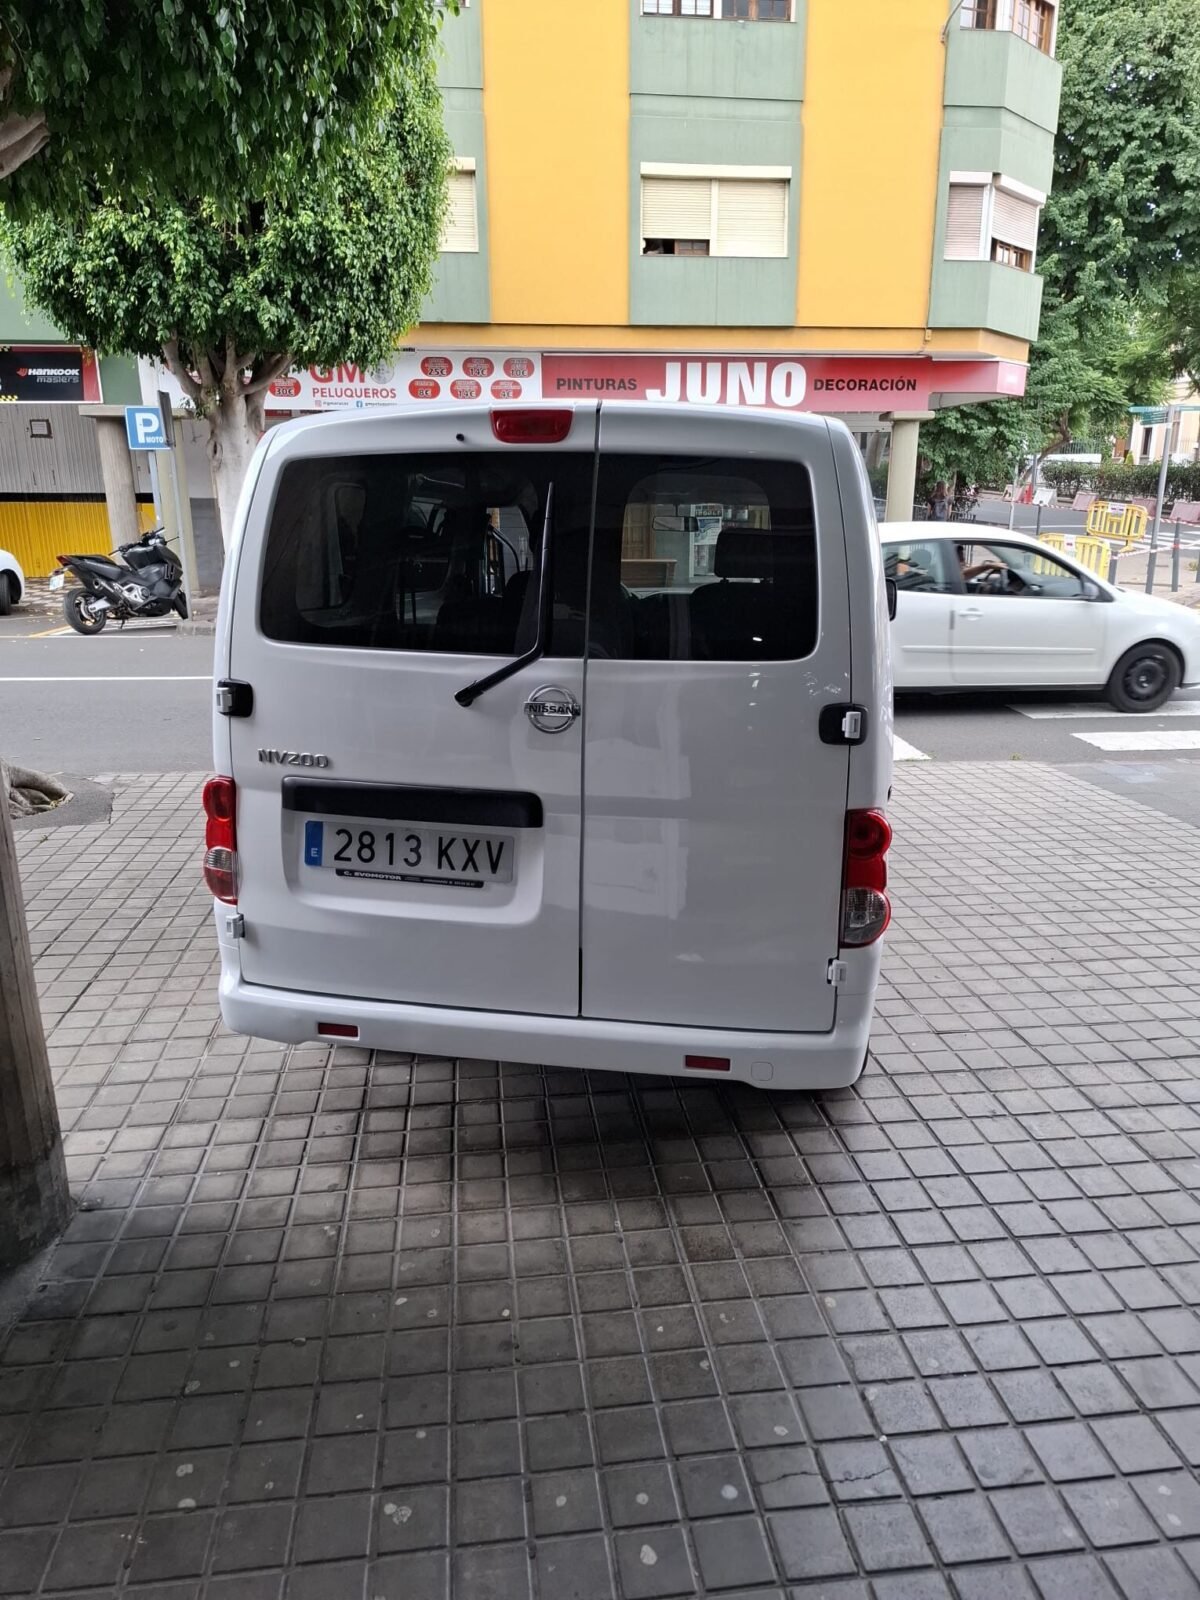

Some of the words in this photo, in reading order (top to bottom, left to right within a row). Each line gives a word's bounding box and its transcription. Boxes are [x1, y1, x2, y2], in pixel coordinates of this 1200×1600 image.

[275, 387, 294, 396] 30€
[556, 378, 637, 391] PINTURAS
[645, 362, 807, 407] JUNO
[814, 376, 917, 392] DECORACIÓN
[312, 387, 397, 399] PELUQUEROS
[135, 412, 160, 443] P
[529, 704, 573, 714] NISSAN
[257, 748, 330, 769] NV200
[310, 847, 319, 858] E
[333, 828, 423, 867] 2813
[437, 836, 505, 874] KXV
